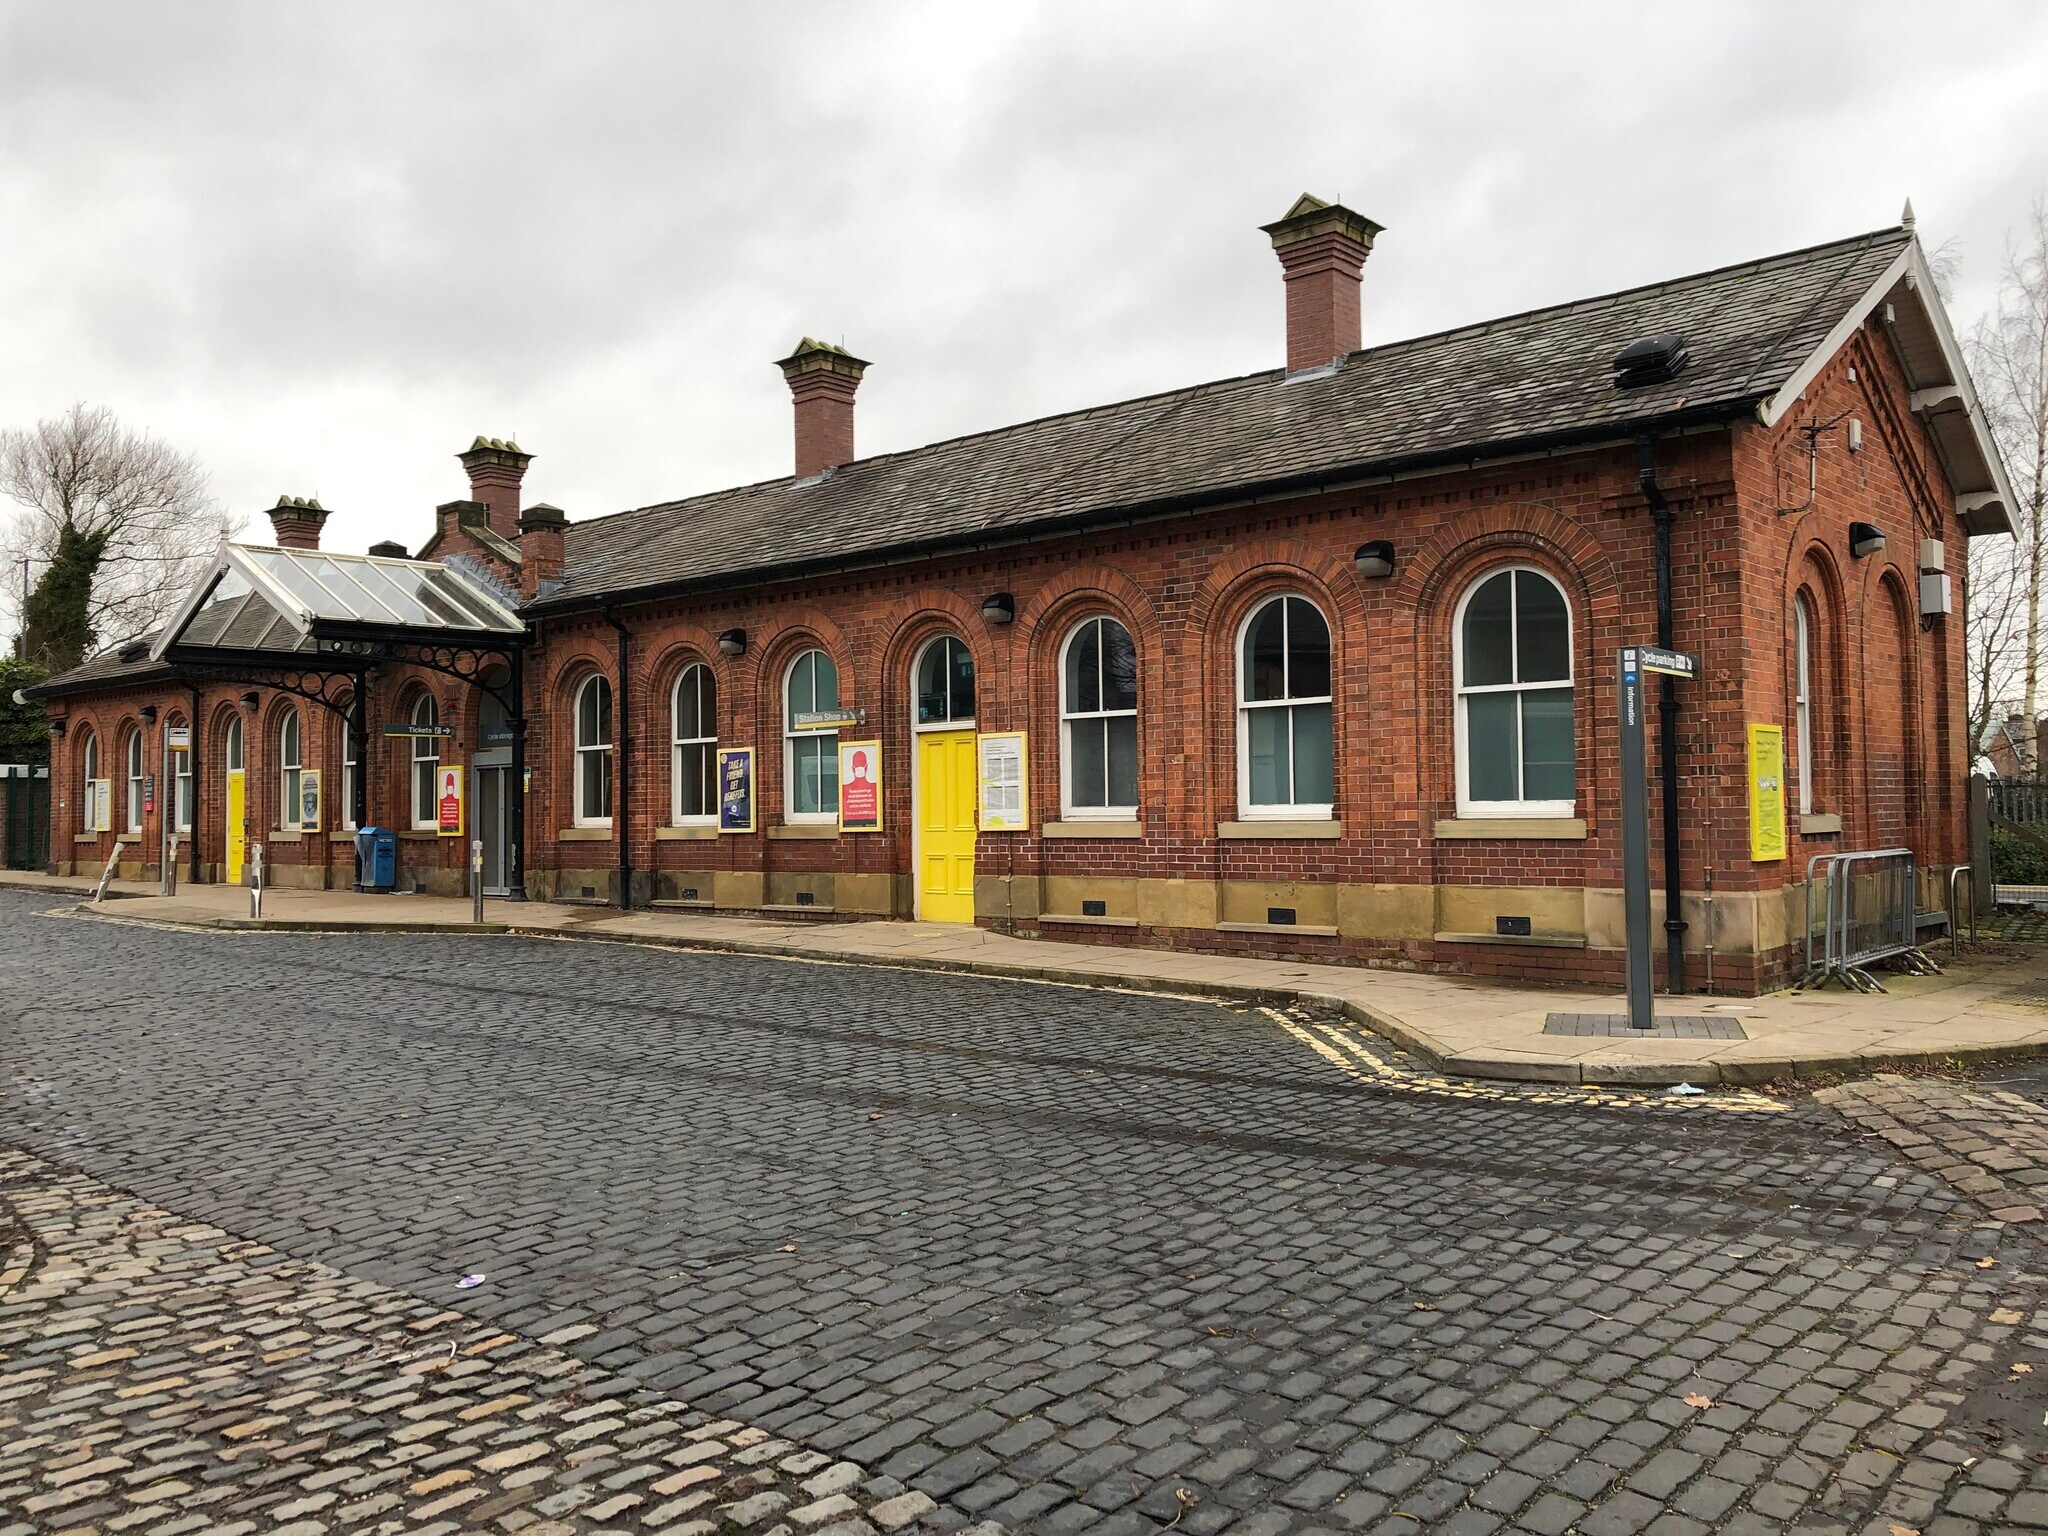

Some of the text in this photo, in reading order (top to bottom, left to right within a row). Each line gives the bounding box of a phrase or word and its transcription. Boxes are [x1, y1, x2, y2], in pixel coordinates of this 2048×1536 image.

[1641, 649, 1675, 669] Cycle parking
[1627, 686, 1636, 726] Information
[799, 713, 841, 723] Station Shop
[408, 726, 433, 734] Tickets
[728, 758, 744, 771] TAKE A
[730, 779, 739, 791] GET
